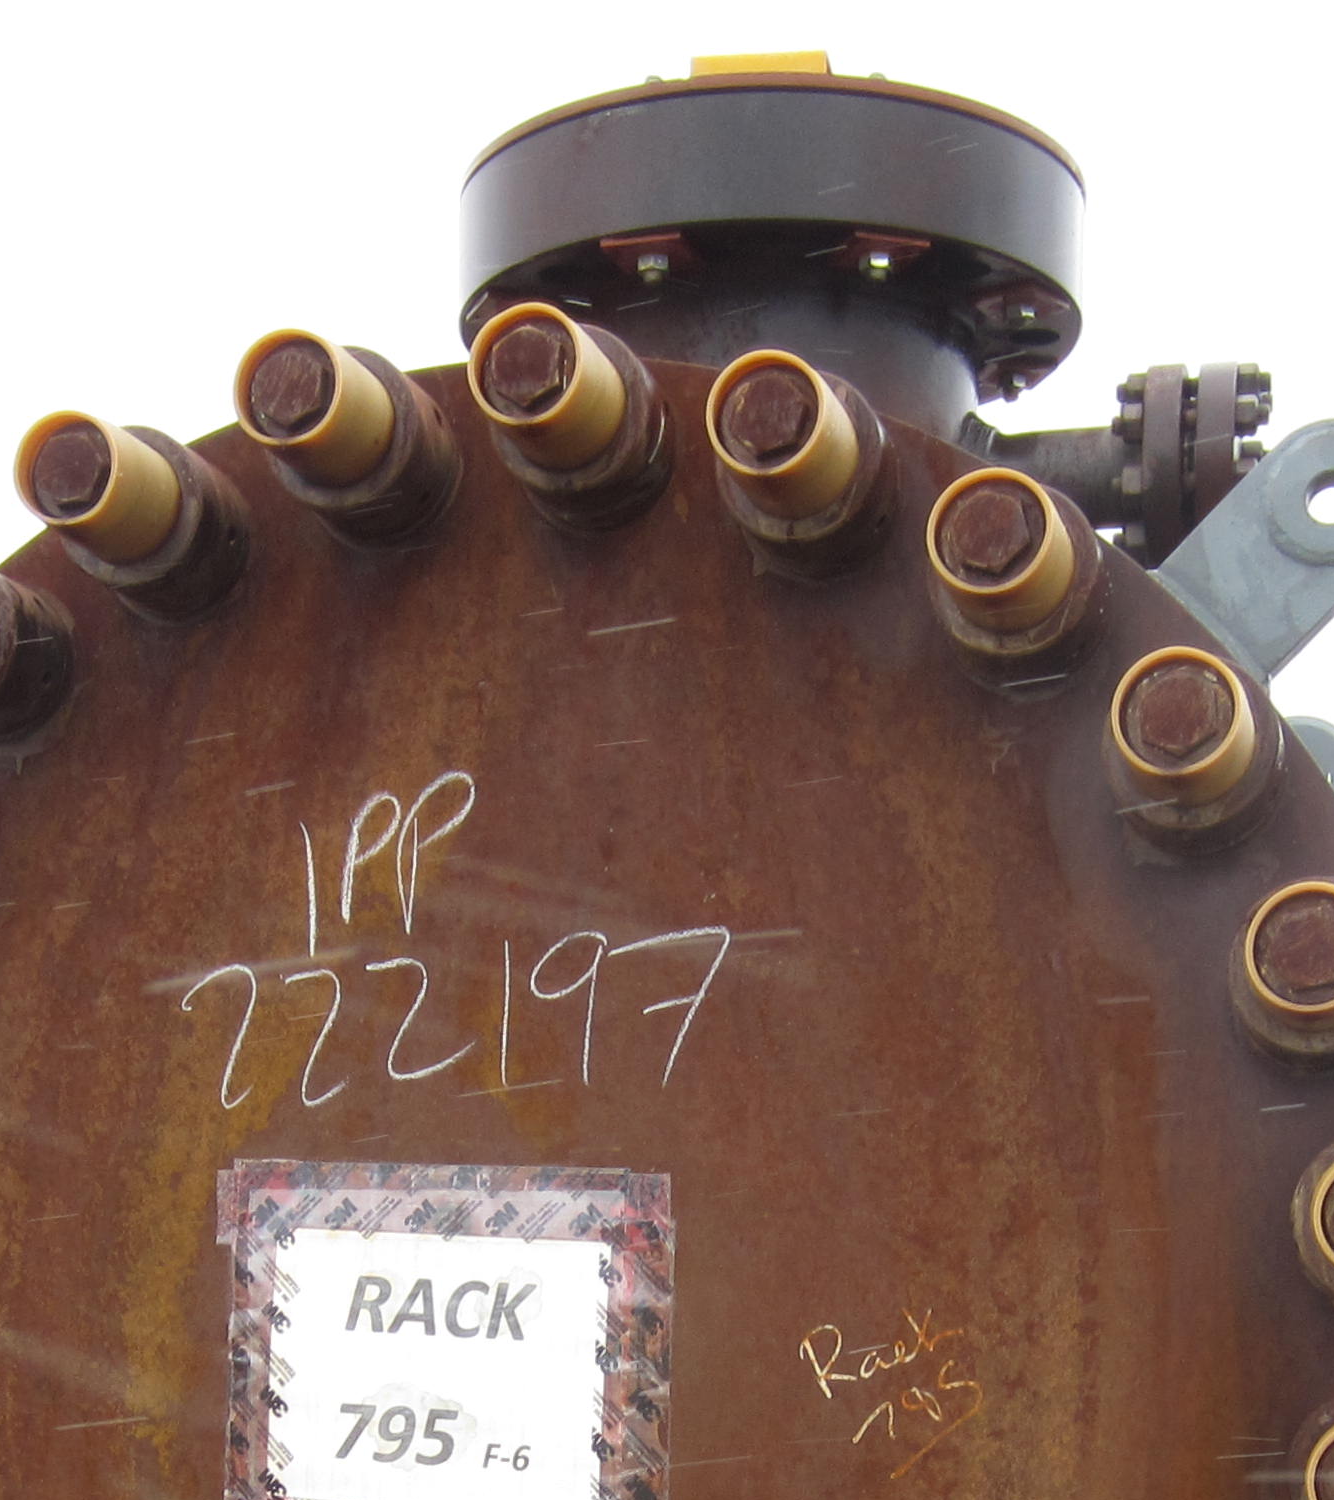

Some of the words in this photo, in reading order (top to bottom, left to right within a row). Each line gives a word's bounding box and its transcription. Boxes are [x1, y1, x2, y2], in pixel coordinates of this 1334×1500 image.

[345, 1275, 537, 1341] RACK
[334, 1403, 459, 1467] 795
[481, 1443, 531, 1472] F-6
